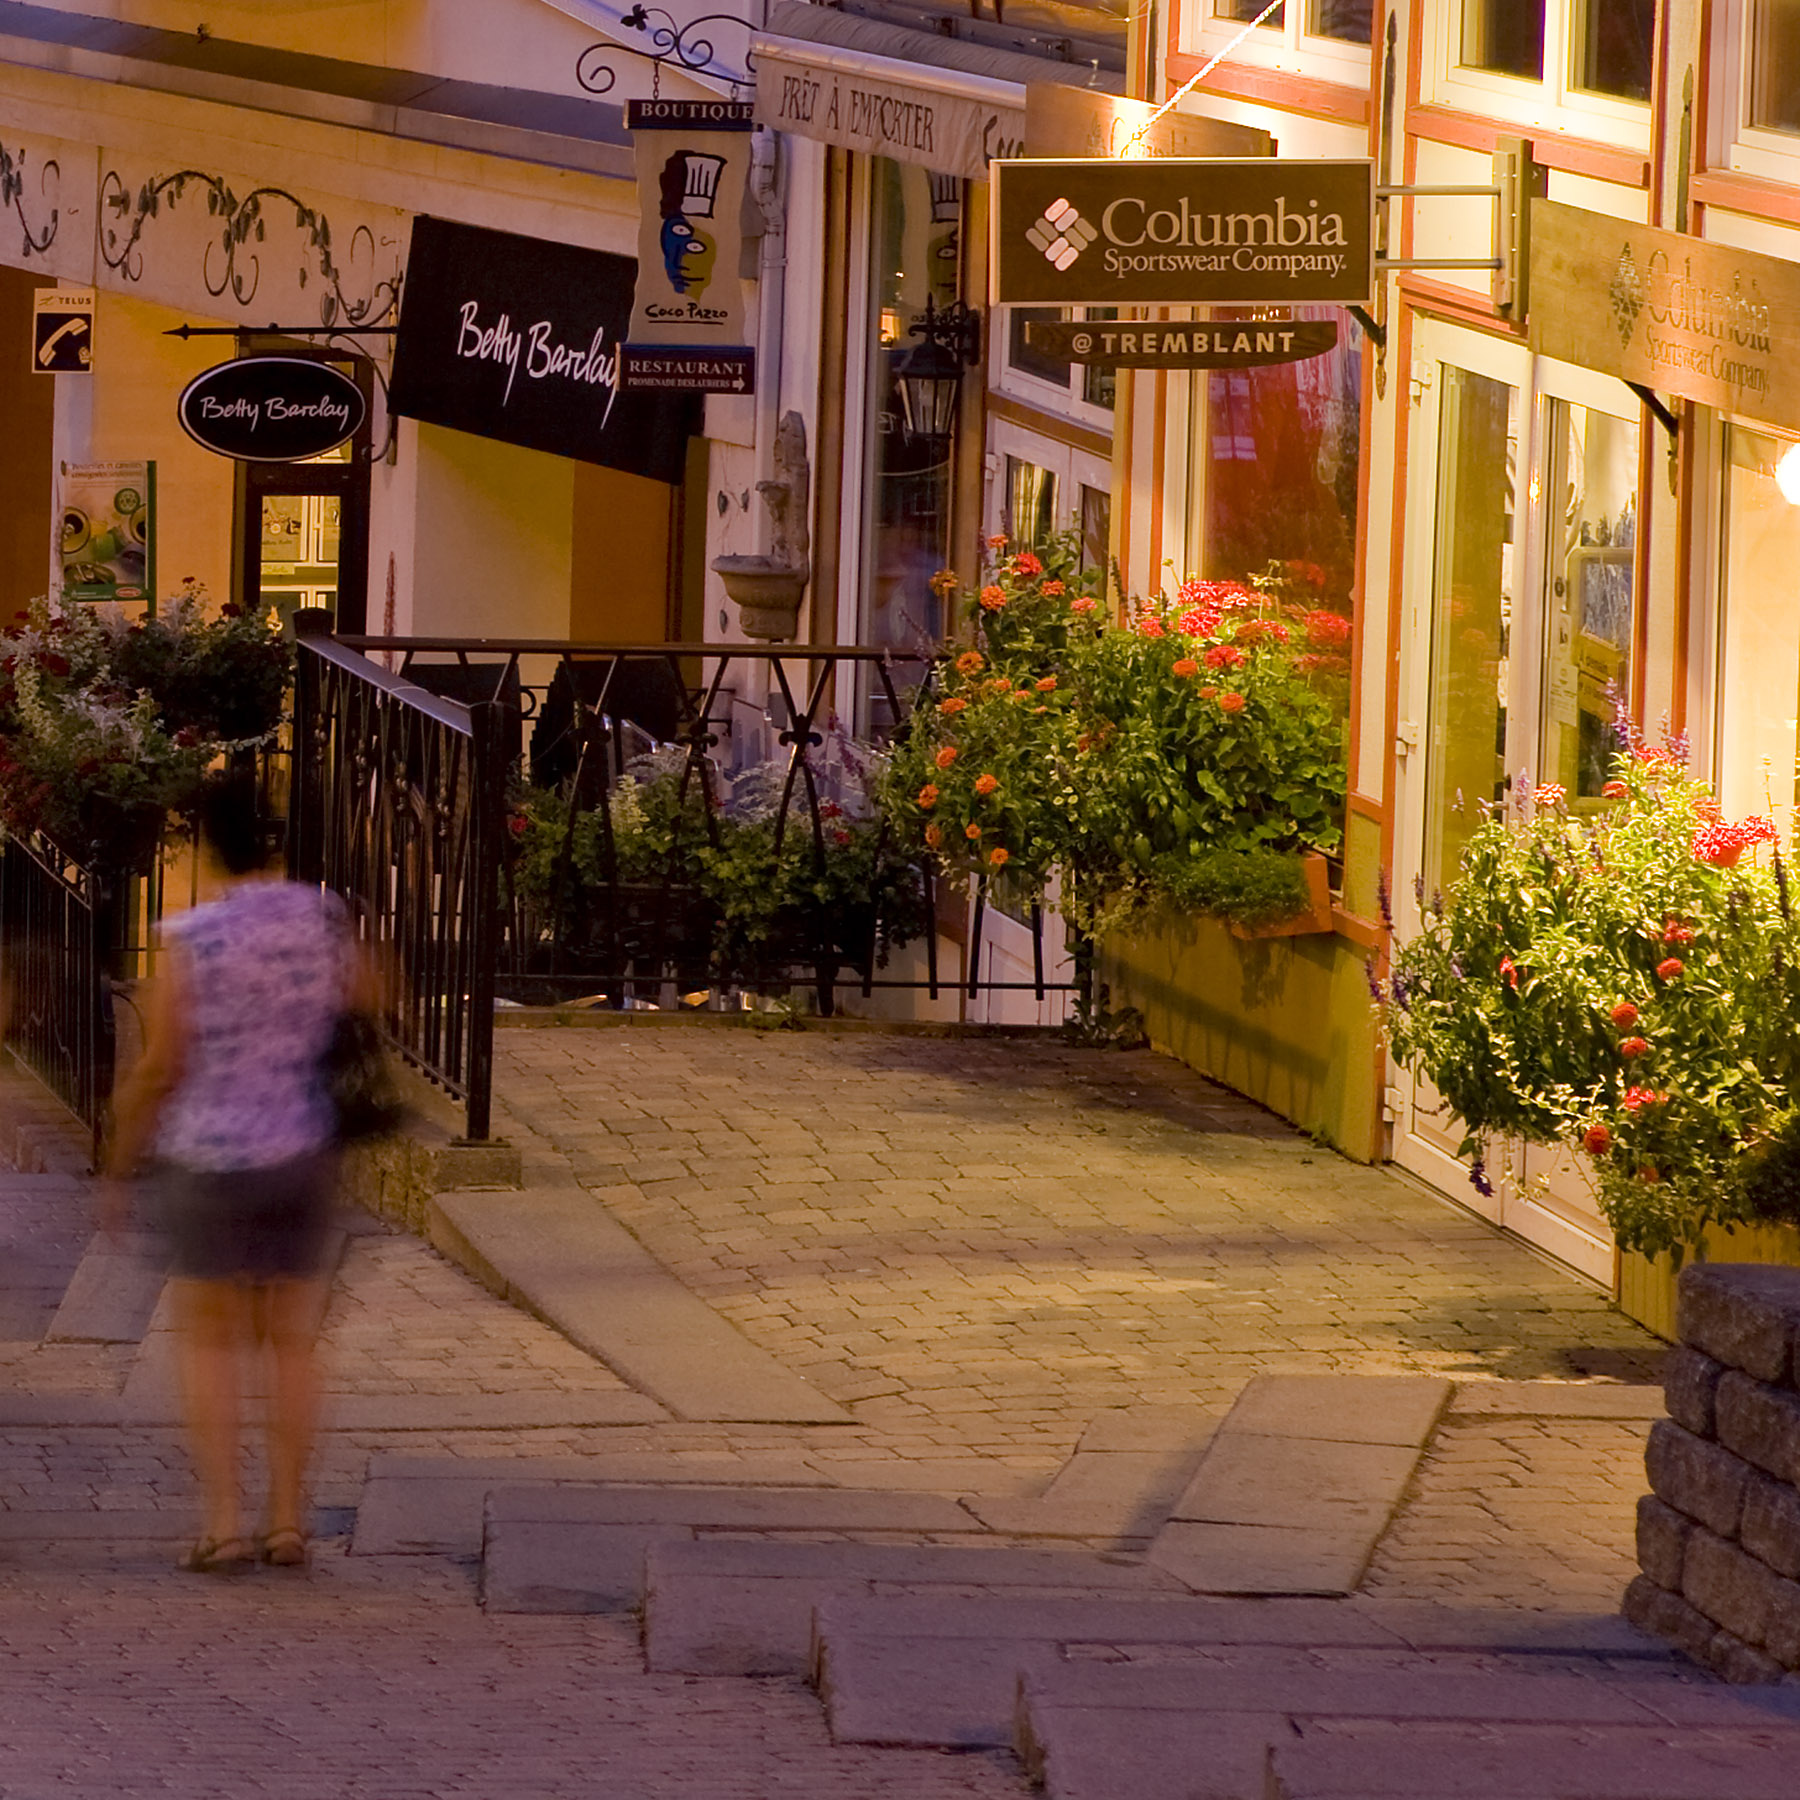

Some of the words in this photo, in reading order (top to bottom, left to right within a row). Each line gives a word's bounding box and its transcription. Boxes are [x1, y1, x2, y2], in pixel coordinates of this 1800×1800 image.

[640, 102, 753, 121] BOUTIQUE
[778, 70, 820, 126] PRÊT
[827, 76, 840, 131] À
[1102, 196, 1348, 249] Columbia
[1103, 248, 1231, 279] Sportswear
[58, 297, 92, 305] TELUS
[1071, 333, 1093, 355] @
[1100, 331, 1295, 354] TREMBLANT
[456, 300, 522, 408] Betty
[526, 320, 617, 431] Barclay
[629, 360, 747, 375] RESTAURANT
[627, 377, 676, 387] PROMENADE
[200, 396, 260, 433] Betty
[264, 394, 350, 432] Barclay
